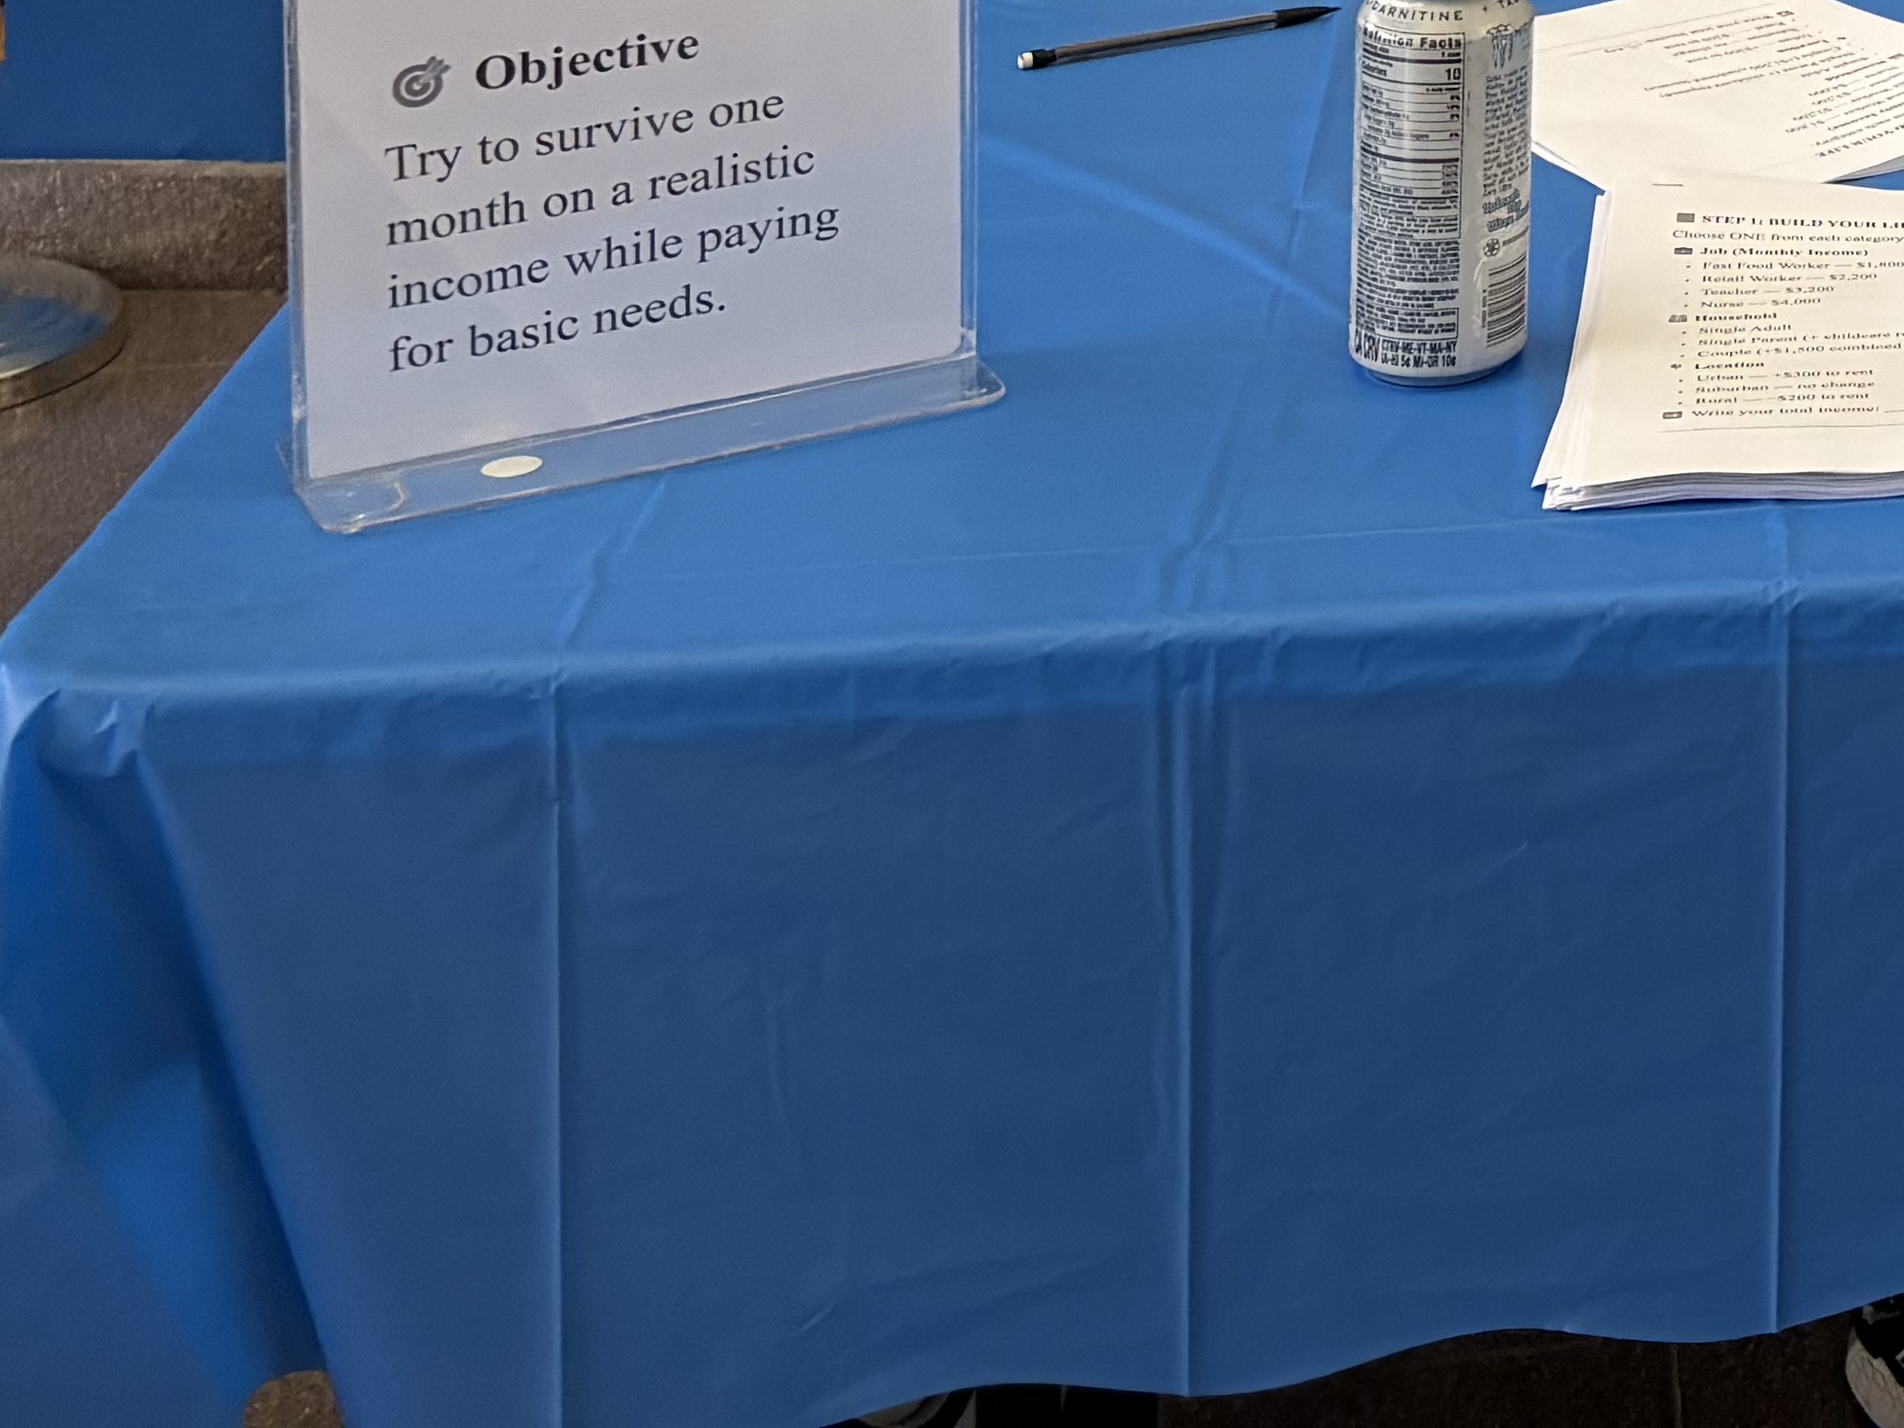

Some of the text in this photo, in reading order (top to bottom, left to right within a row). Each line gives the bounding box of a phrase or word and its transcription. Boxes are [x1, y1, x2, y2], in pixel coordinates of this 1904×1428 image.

[474, 31, 702, 93] Objective
[384, 94, 788, 185] Try to survive one
[385, 143, 818, 248] month on a realistic
[1702, 214, 1747, 225] STEP
[1769, 218, 1823, 228] BUILD
[1827, 219, 1877, 229] YOUR
[387, 202, 842, 311] income while paying
[1672, 229, 1726, 241] Choose
[1729, 231, 1766, 241] ONE
[1771, 232, 1804, 242] from
[1809, 233, 1841, 243] each
[1700, 246, 1729, 256] Job
[387, 283, 729, 375] for basic needs.
